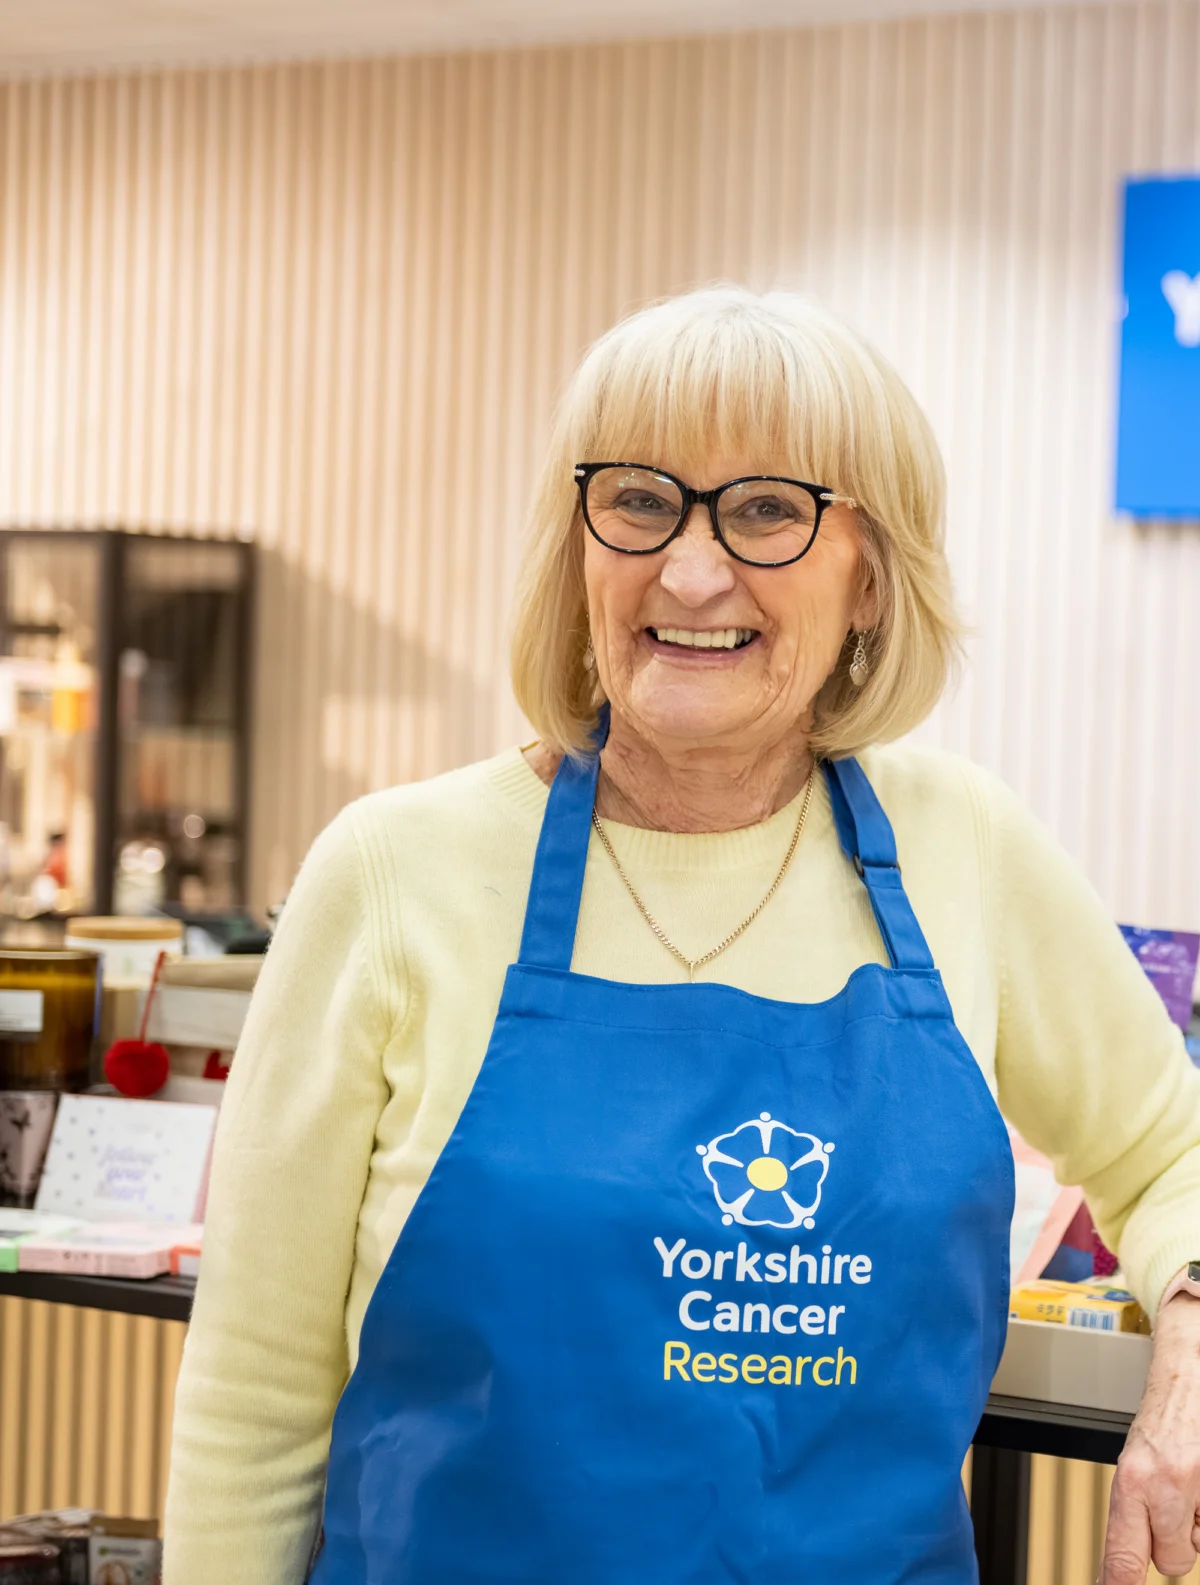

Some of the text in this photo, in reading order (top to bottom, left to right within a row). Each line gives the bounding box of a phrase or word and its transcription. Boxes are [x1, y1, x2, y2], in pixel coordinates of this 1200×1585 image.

[653, 1236, 872, 1285] Yorkshire
[678, 1290, 845, 1335] Cancer
[662, 1340, 858, 1386] Research
